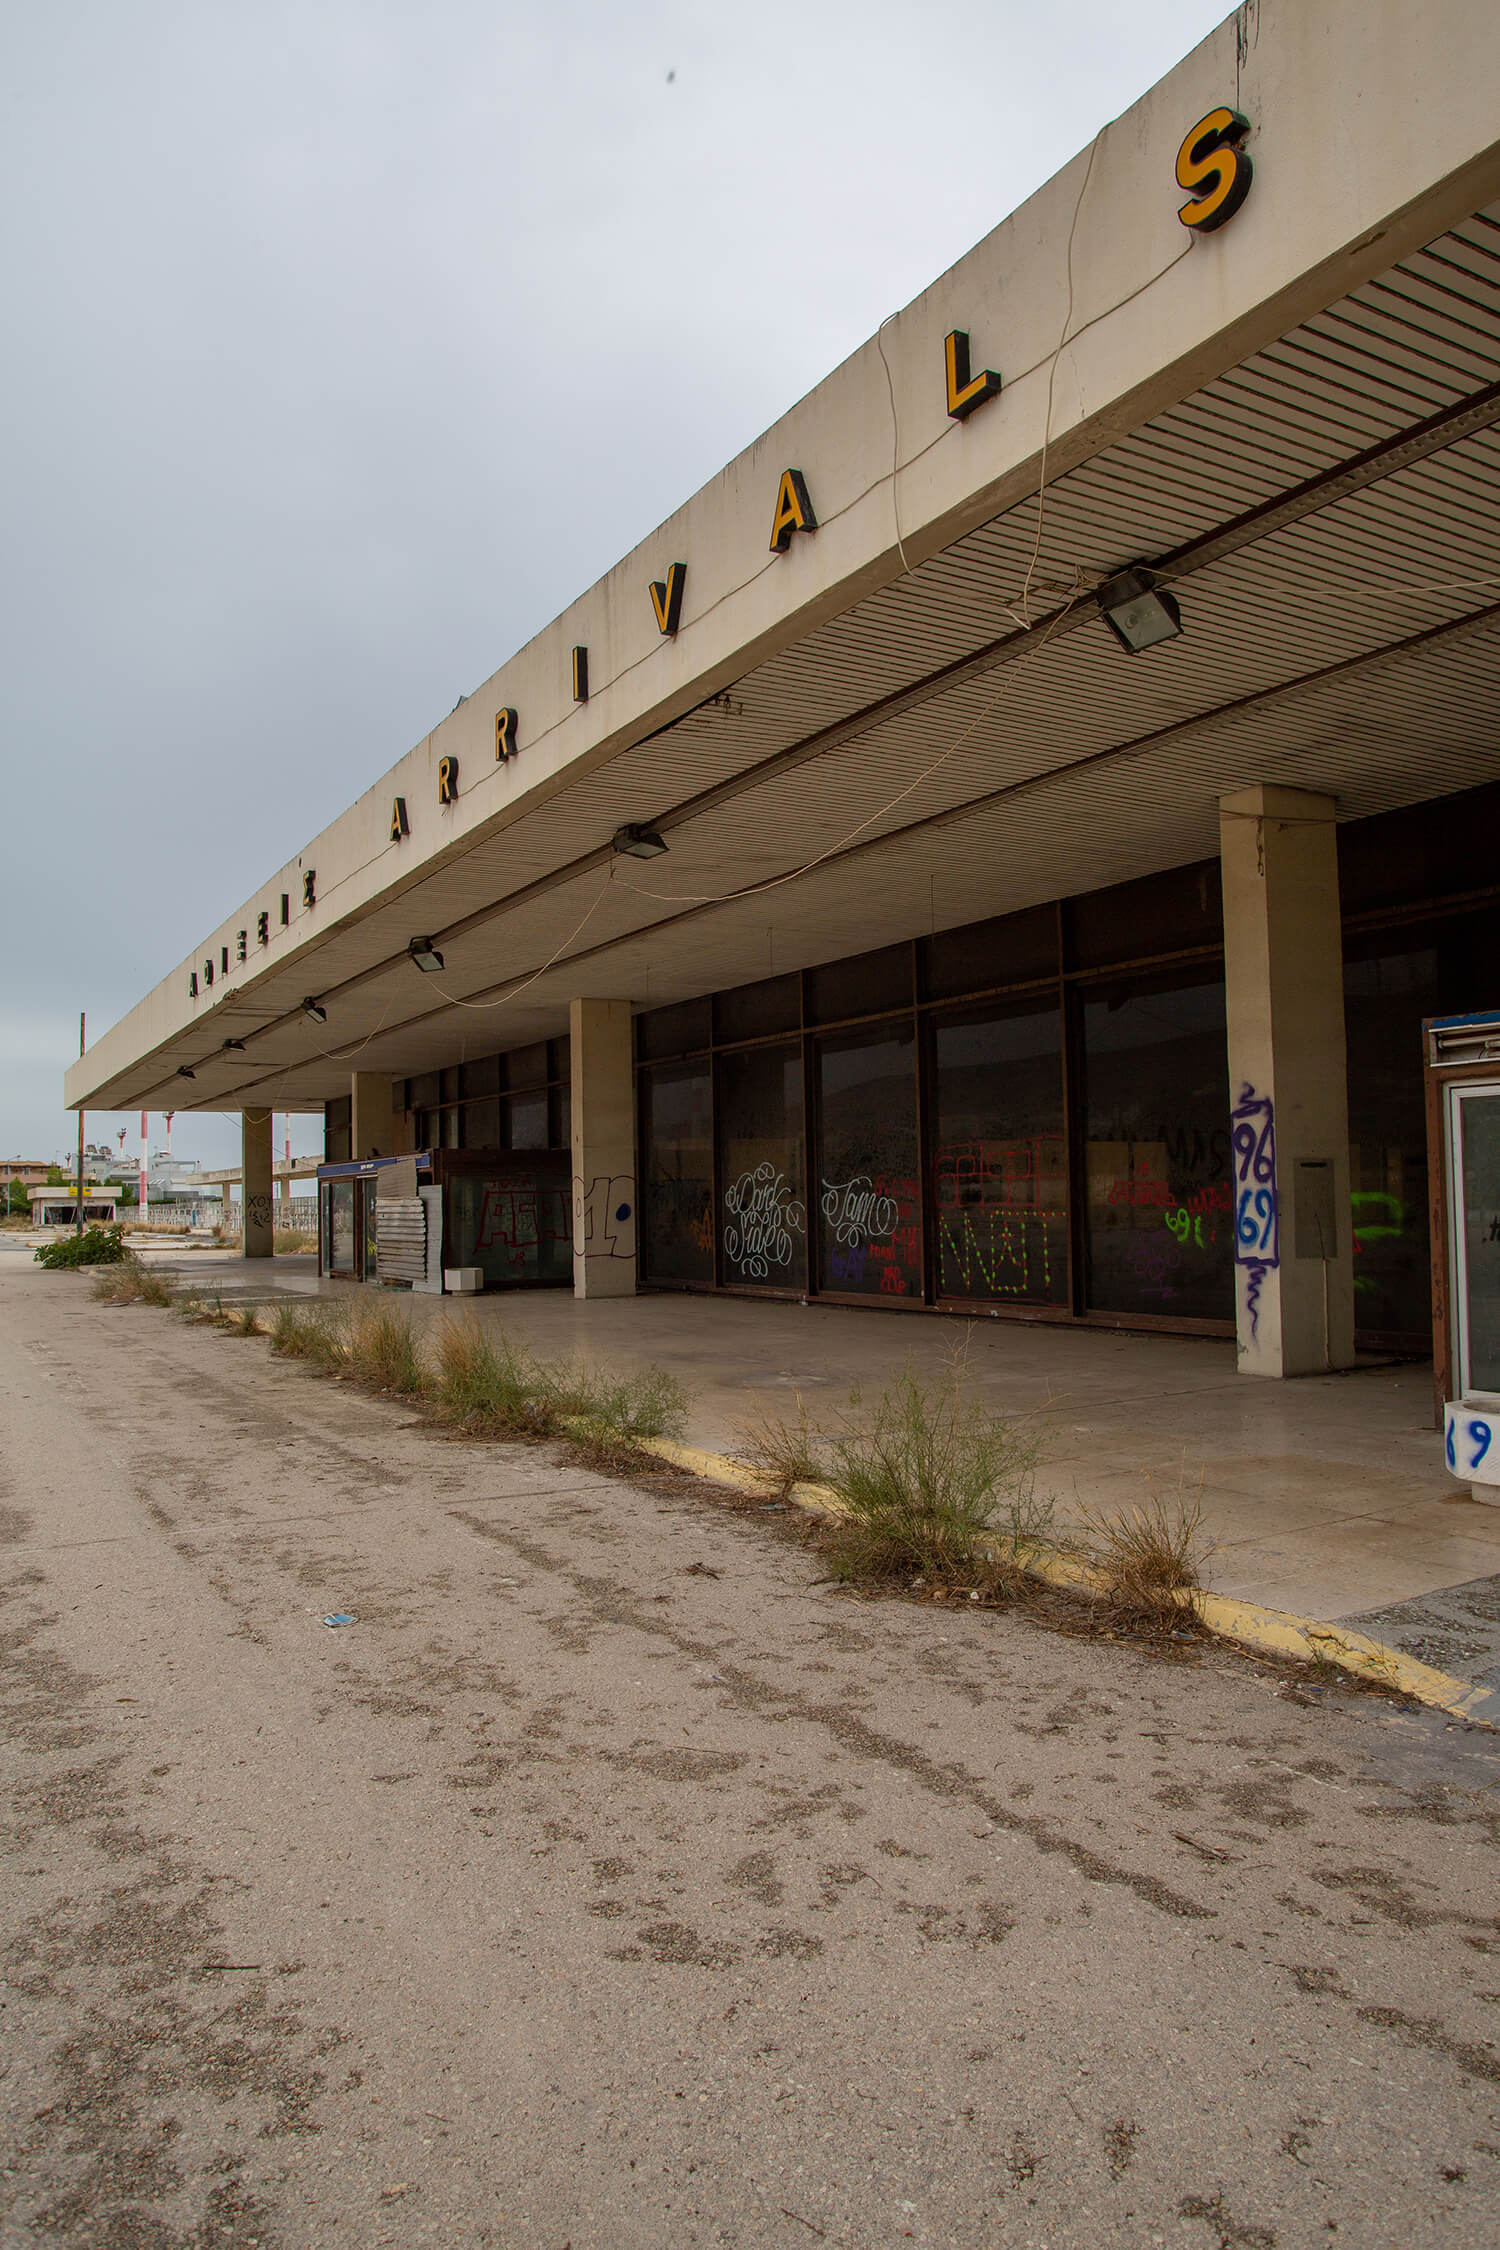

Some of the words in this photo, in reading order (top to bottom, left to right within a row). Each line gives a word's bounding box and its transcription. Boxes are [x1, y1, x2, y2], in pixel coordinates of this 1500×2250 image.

[390, 106, 1253, 841] ARRIVALS
[1232, 1120, 1273, 1183] 96
[1238, 1188, 1274, 1249] 69
